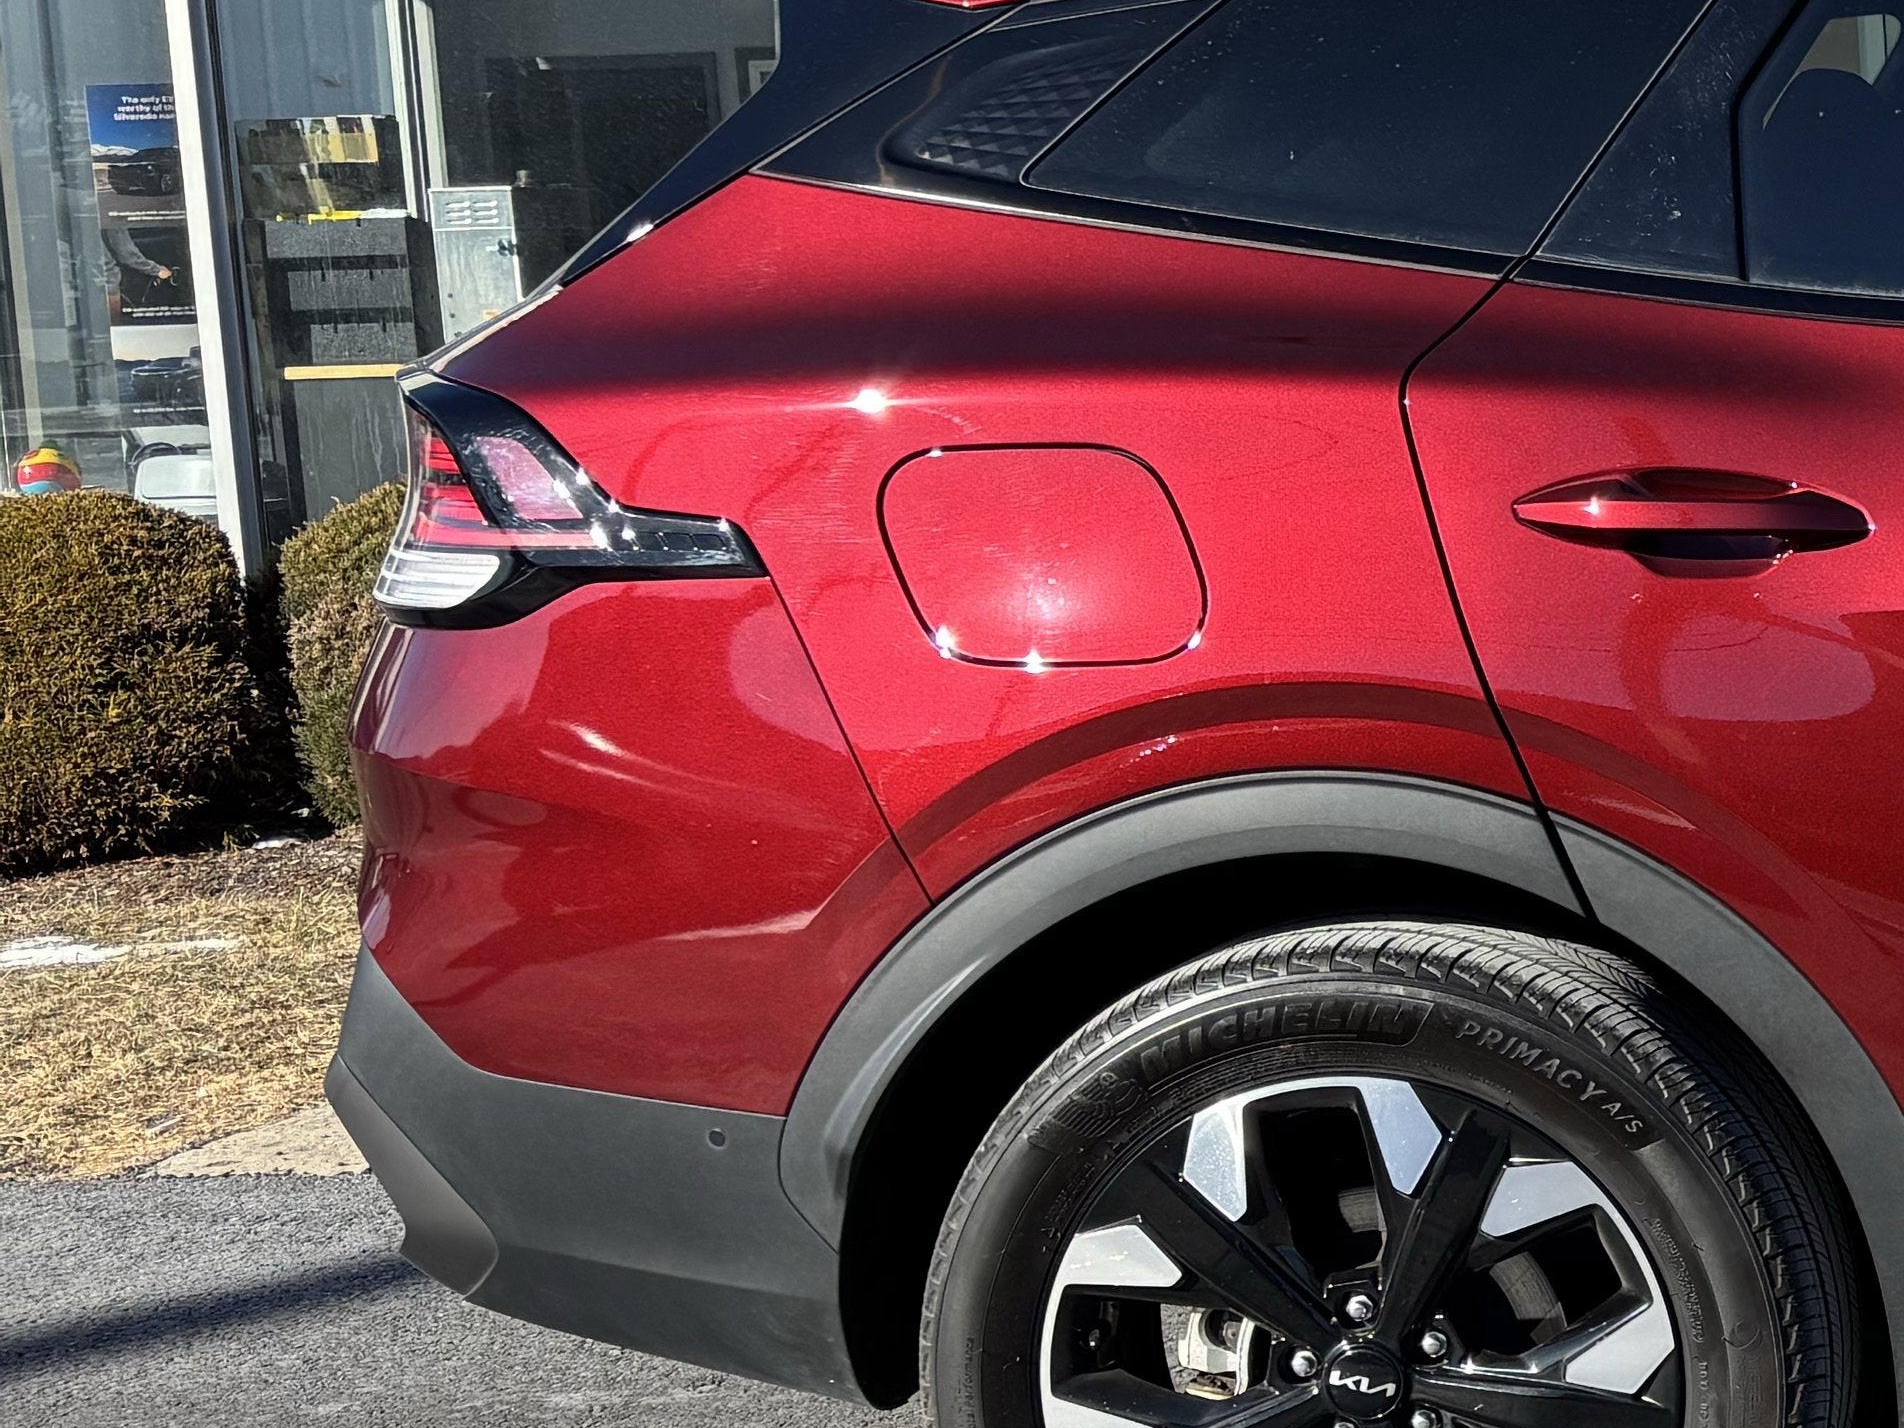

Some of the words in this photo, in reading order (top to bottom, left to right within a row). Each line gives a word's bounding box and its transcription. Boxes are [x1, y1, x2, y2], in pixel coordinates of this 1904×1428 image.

[1140, 1000, 1422, 1072] MICHELIN
[1454, 1021, 1607, 1106] PRIMACY
[1601, 1101, 1643, 1134] A/S
